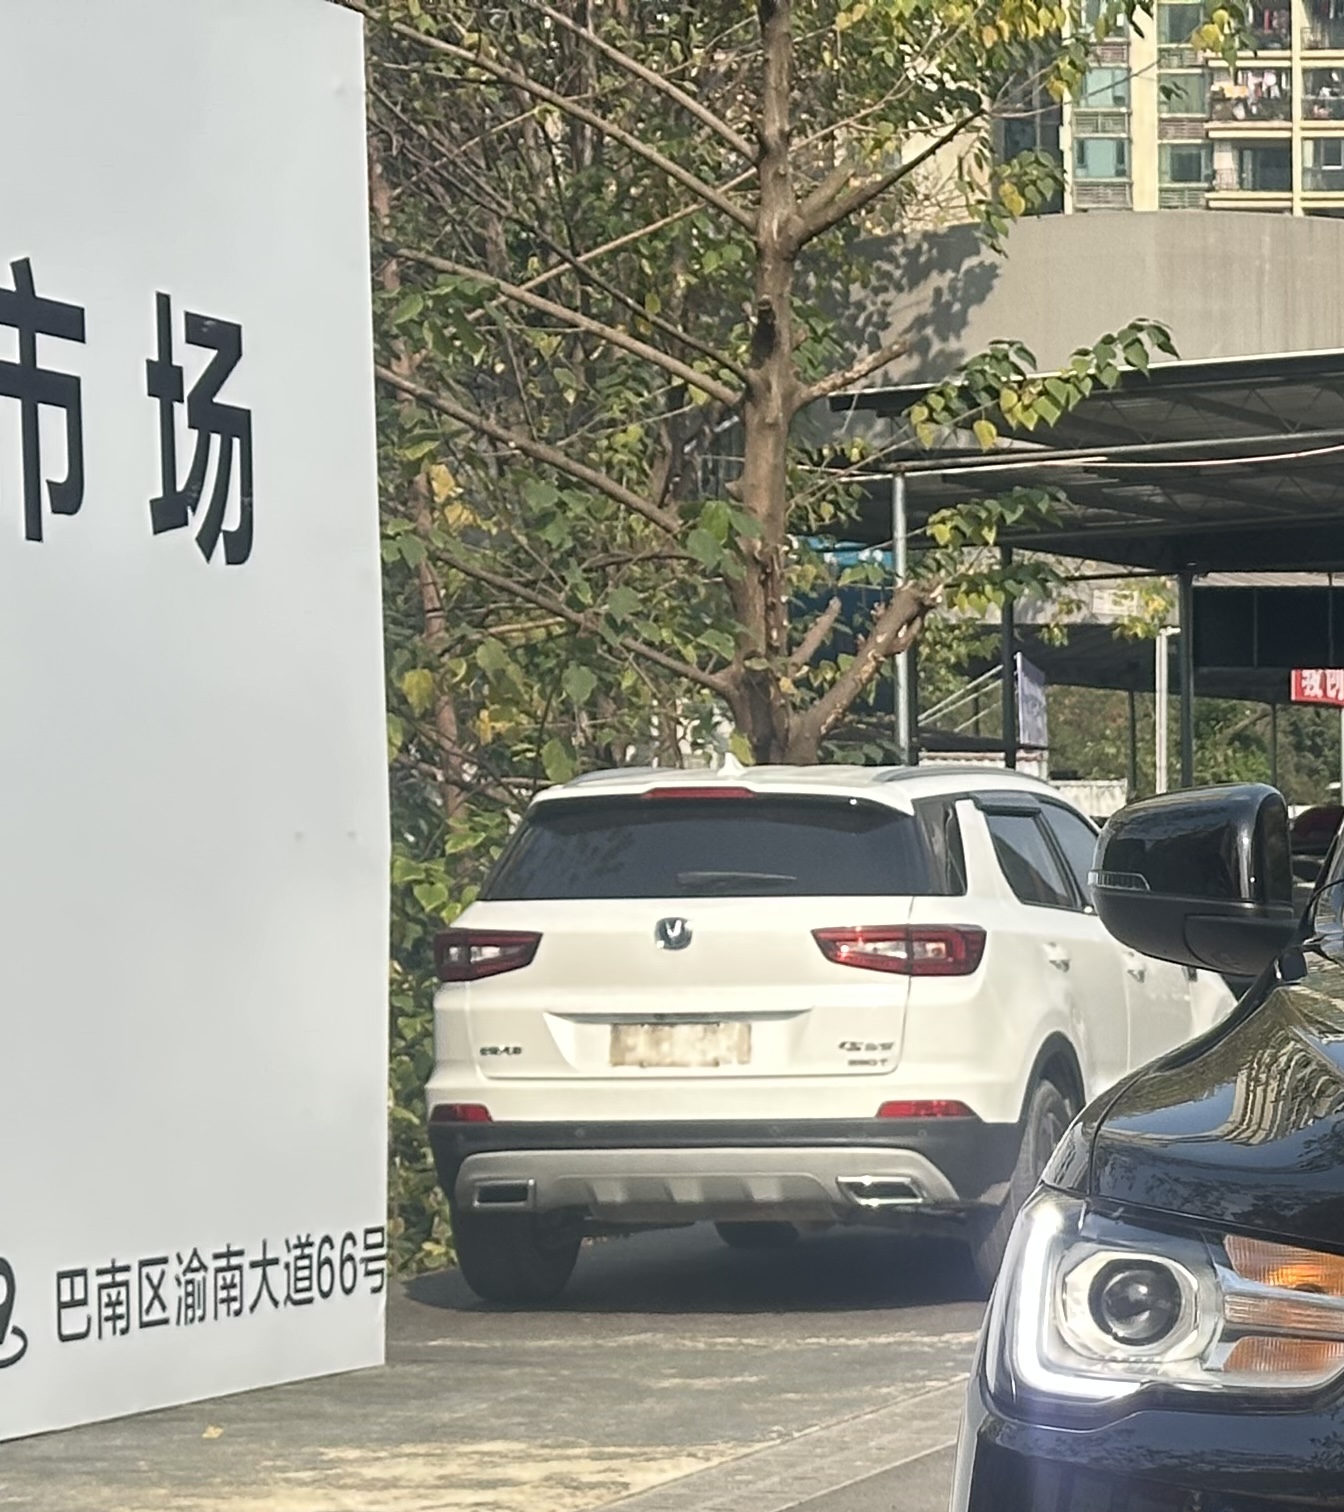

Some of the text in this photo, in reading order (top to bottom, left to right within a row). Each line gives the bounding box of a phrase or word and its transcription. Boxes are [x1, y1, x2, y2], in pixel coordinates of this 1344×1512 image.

[0, 257, 254, 566] 市场
[56, 1226, 386, 1342] 巴南区渝南大道66号
